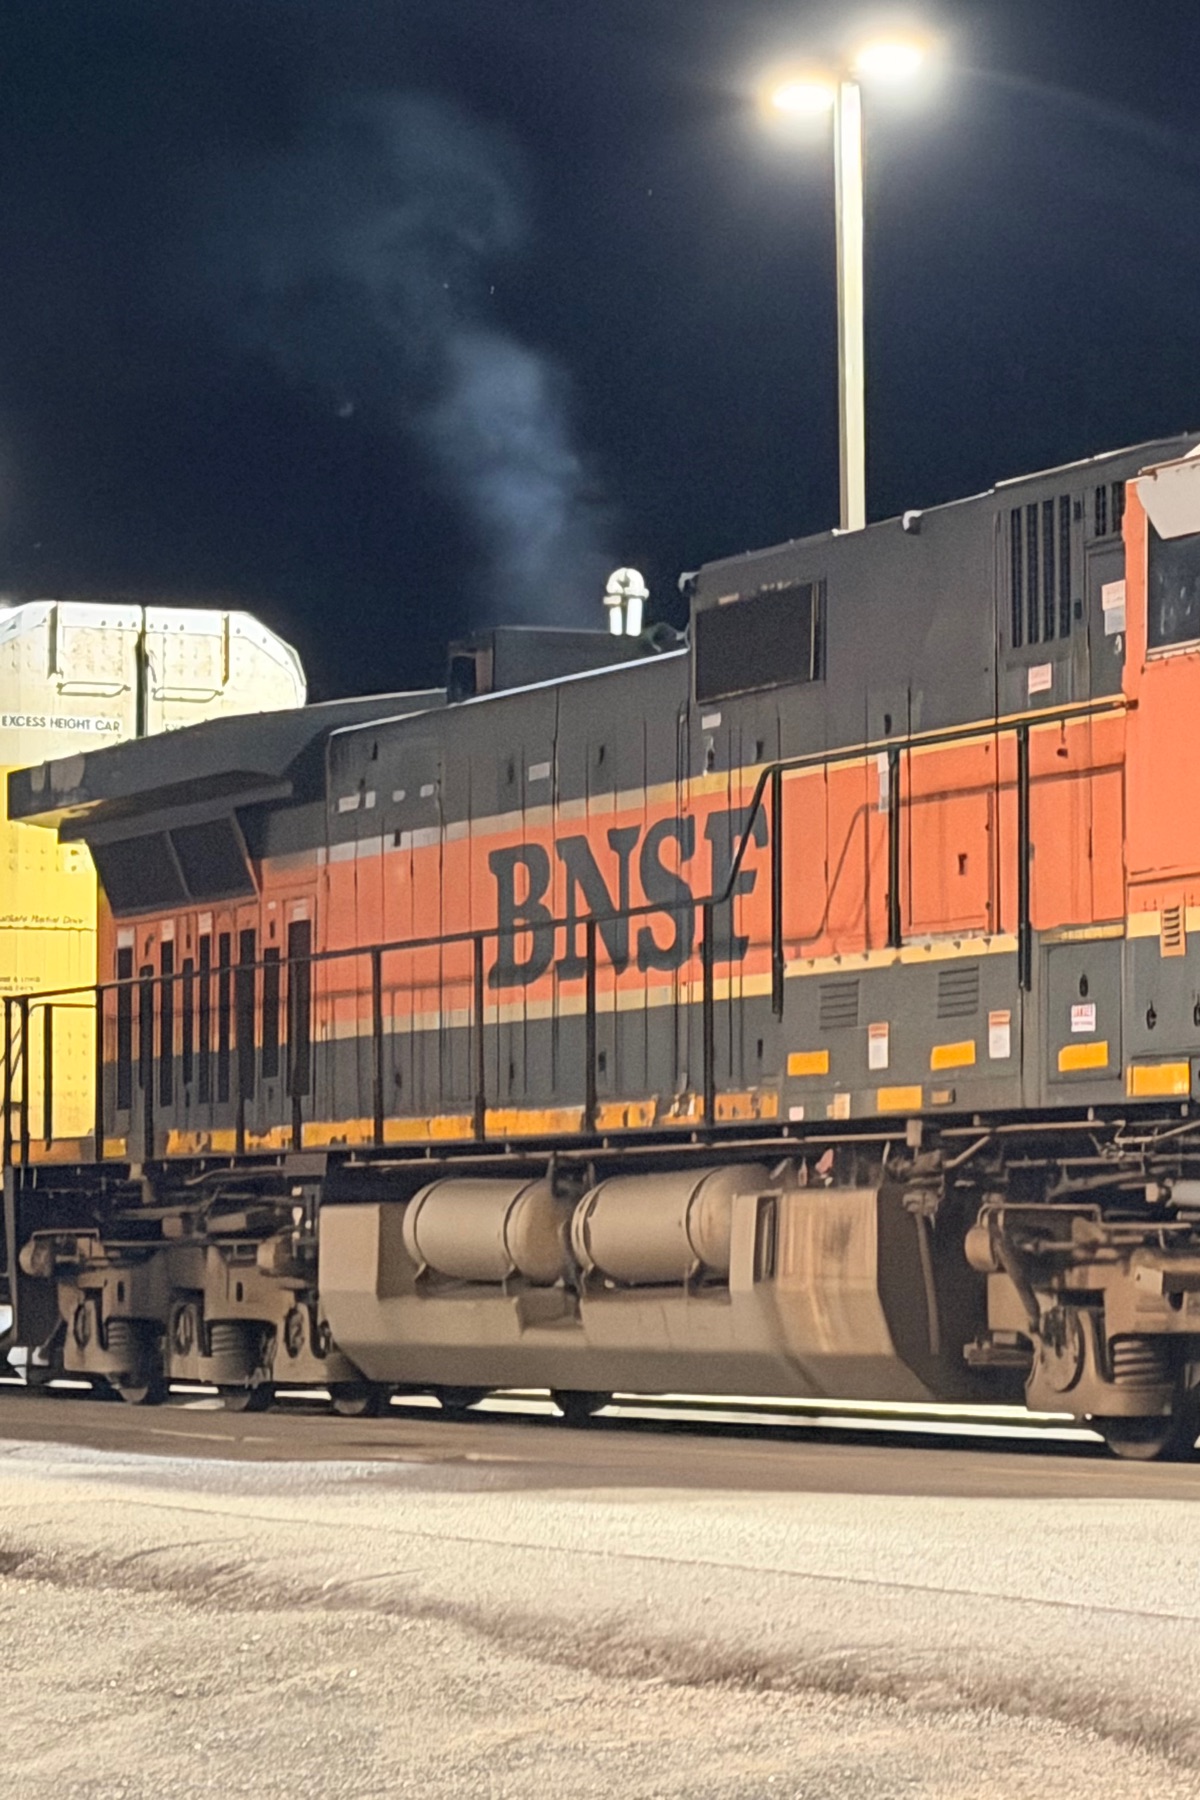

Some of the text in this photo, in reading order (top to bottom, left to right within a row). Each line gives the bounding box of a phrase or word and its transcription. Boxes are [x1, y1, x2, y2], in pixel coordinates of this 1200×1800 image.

[1, 715, 120, 732] EXCESS HEIGHT CAR
[488, 803, 769, 990] BNSF
